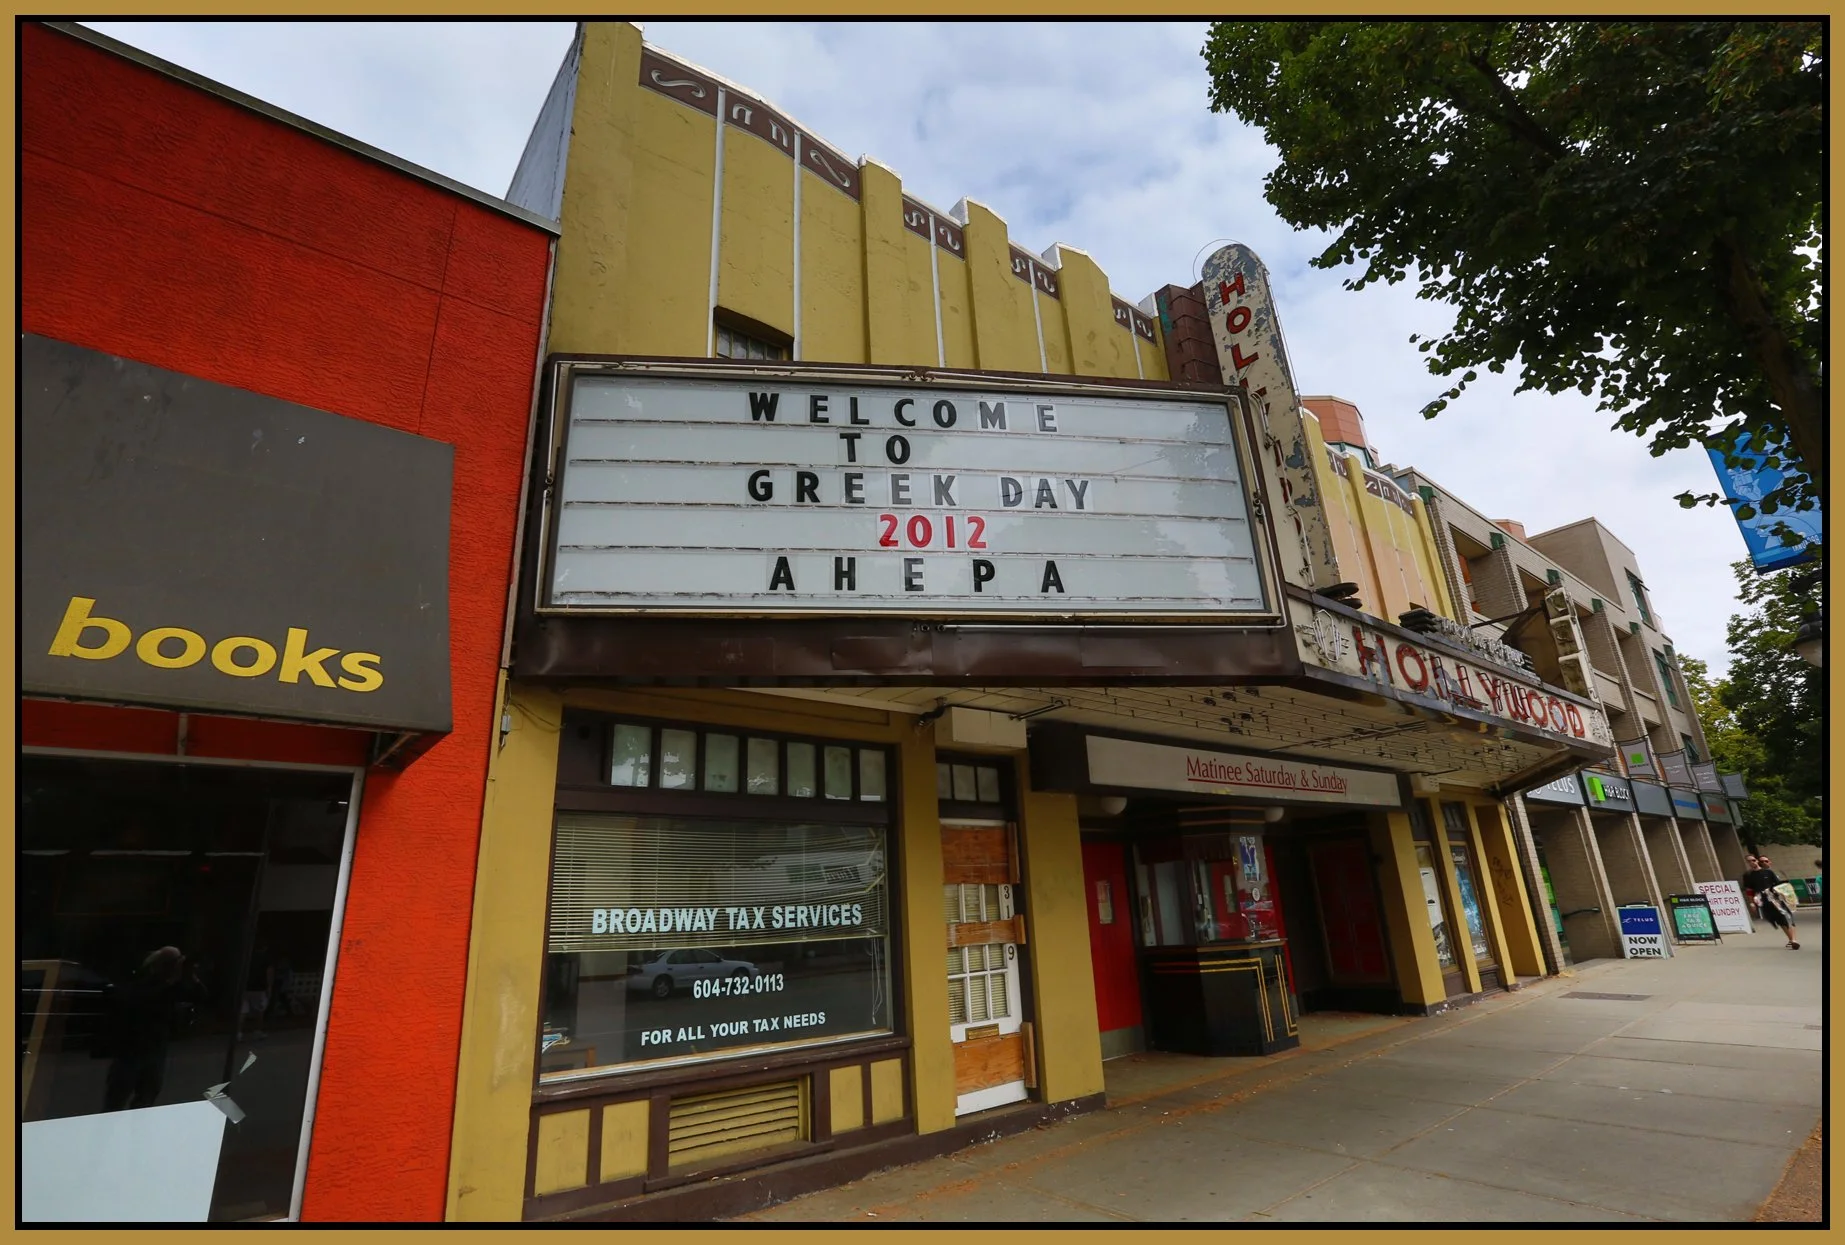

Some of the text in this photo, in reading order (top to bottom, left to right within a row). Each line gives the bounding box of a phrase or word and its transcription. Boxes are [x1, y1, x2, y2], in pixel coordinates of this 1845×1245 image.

[749, 392, 1058, 433] WELCOME
[840, 433, 910, 466] TO
[748, 470, 1089, 510] GREEK DAY
[878, 514, 988, 549] 2012
[769, 556, 1065, 595] AHEPA
[48, 596, 385, 692] books
[1352, 625, 1585, 738] HOLLYWOOD
[1186, 755, 1348, 795] Matinee Saturday & Sunday
[1698, 884, 1736, 894] SPECIAL
[1708, 896, 1740, 906] HIRT FOR
[592, 902, 863, 934] BROADWAY TAX SERVICES
[1712, 908, 1740, 917] AUNDRY
[1628, 936, 1658, 944] NOW
[1630, 947, 1662, 956] OPEN
[693, 973, 784, 999] 604-732-0113
[640, 1011, 826, 1046] FOR ALL YOUR TAX NEEDS
